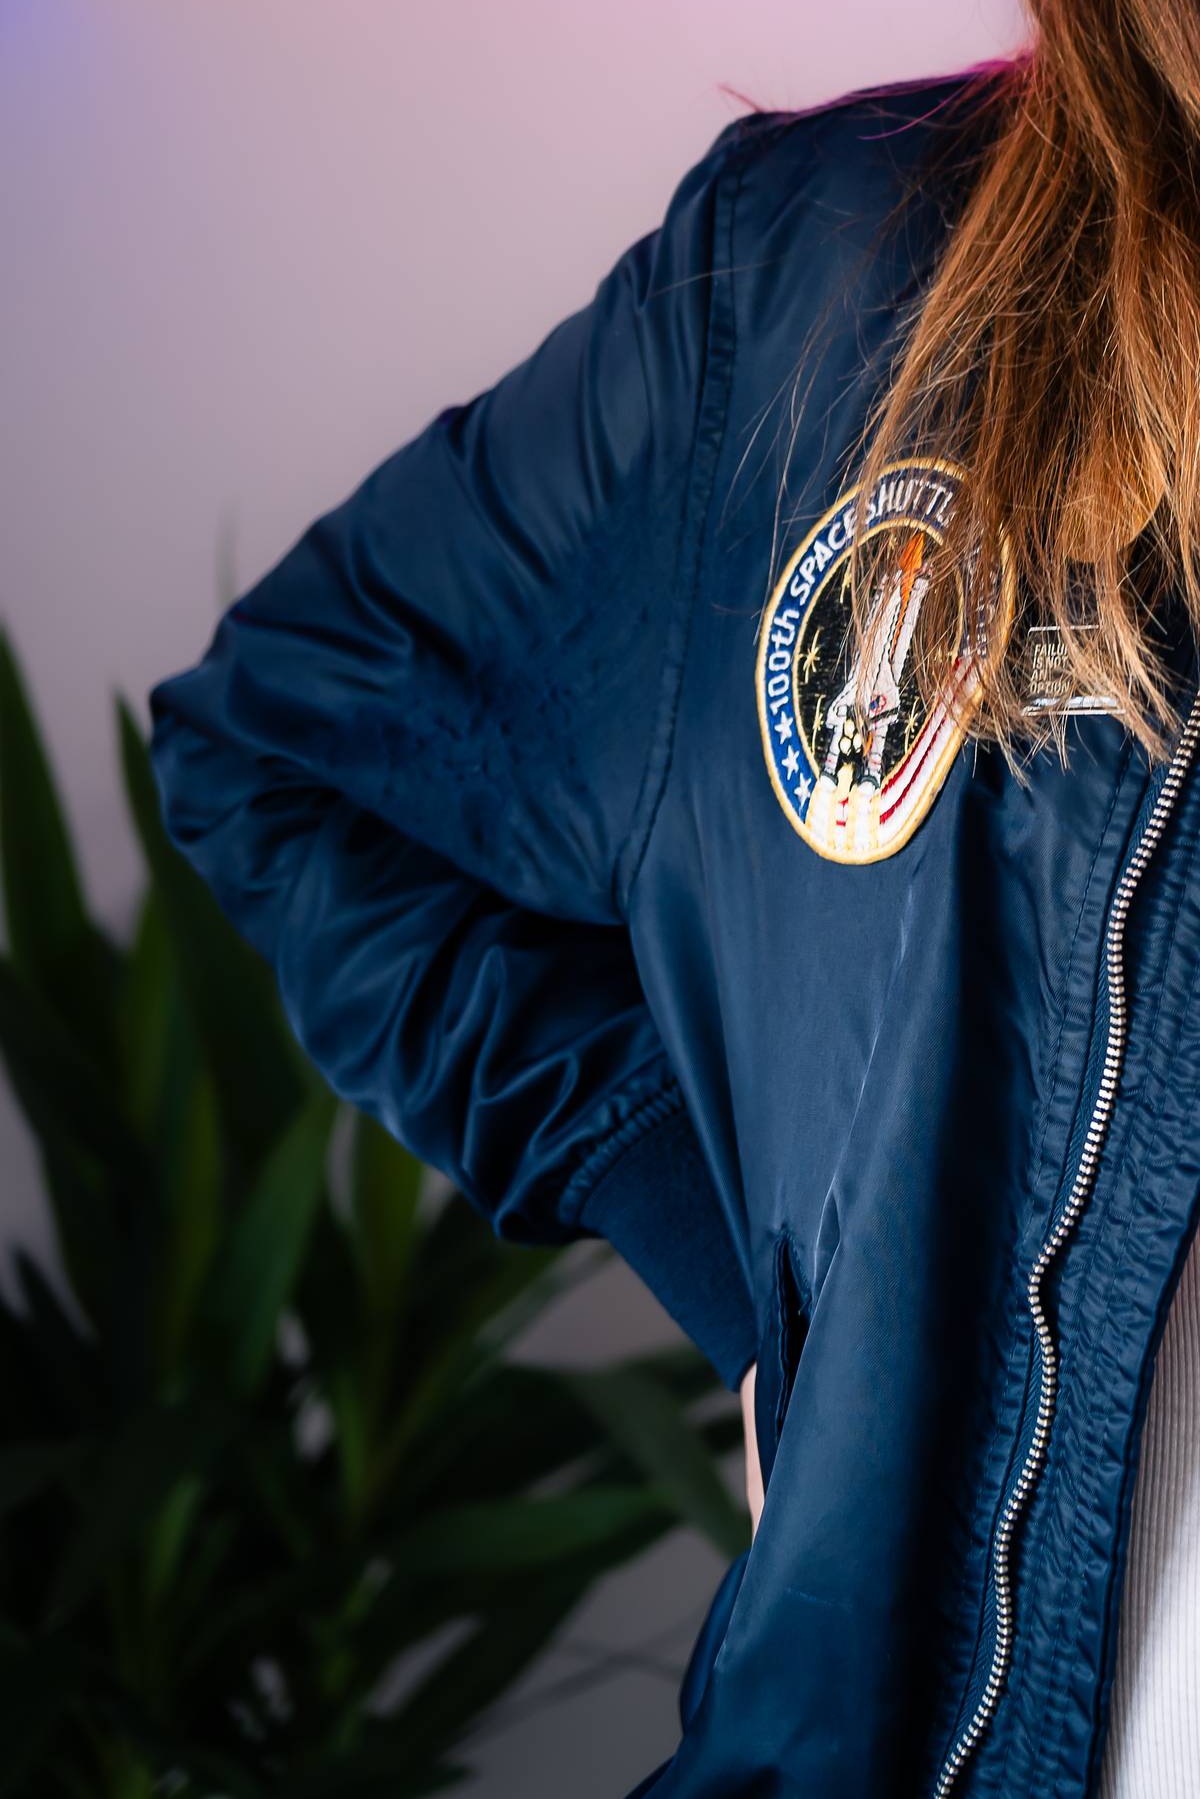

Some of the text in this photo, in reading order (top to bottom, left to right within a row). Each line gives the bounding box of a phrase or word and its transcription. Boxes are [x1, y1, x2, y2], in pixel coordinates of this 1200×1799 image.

[767, 607, 800, 716] 100th
[790, 506, 859, 606] SPACE
[1034, 643, 1069, 656] FAILU
[1032, 655, 1069, 669] IS NOT
[1030, 681, 1070, 694] OPTION
